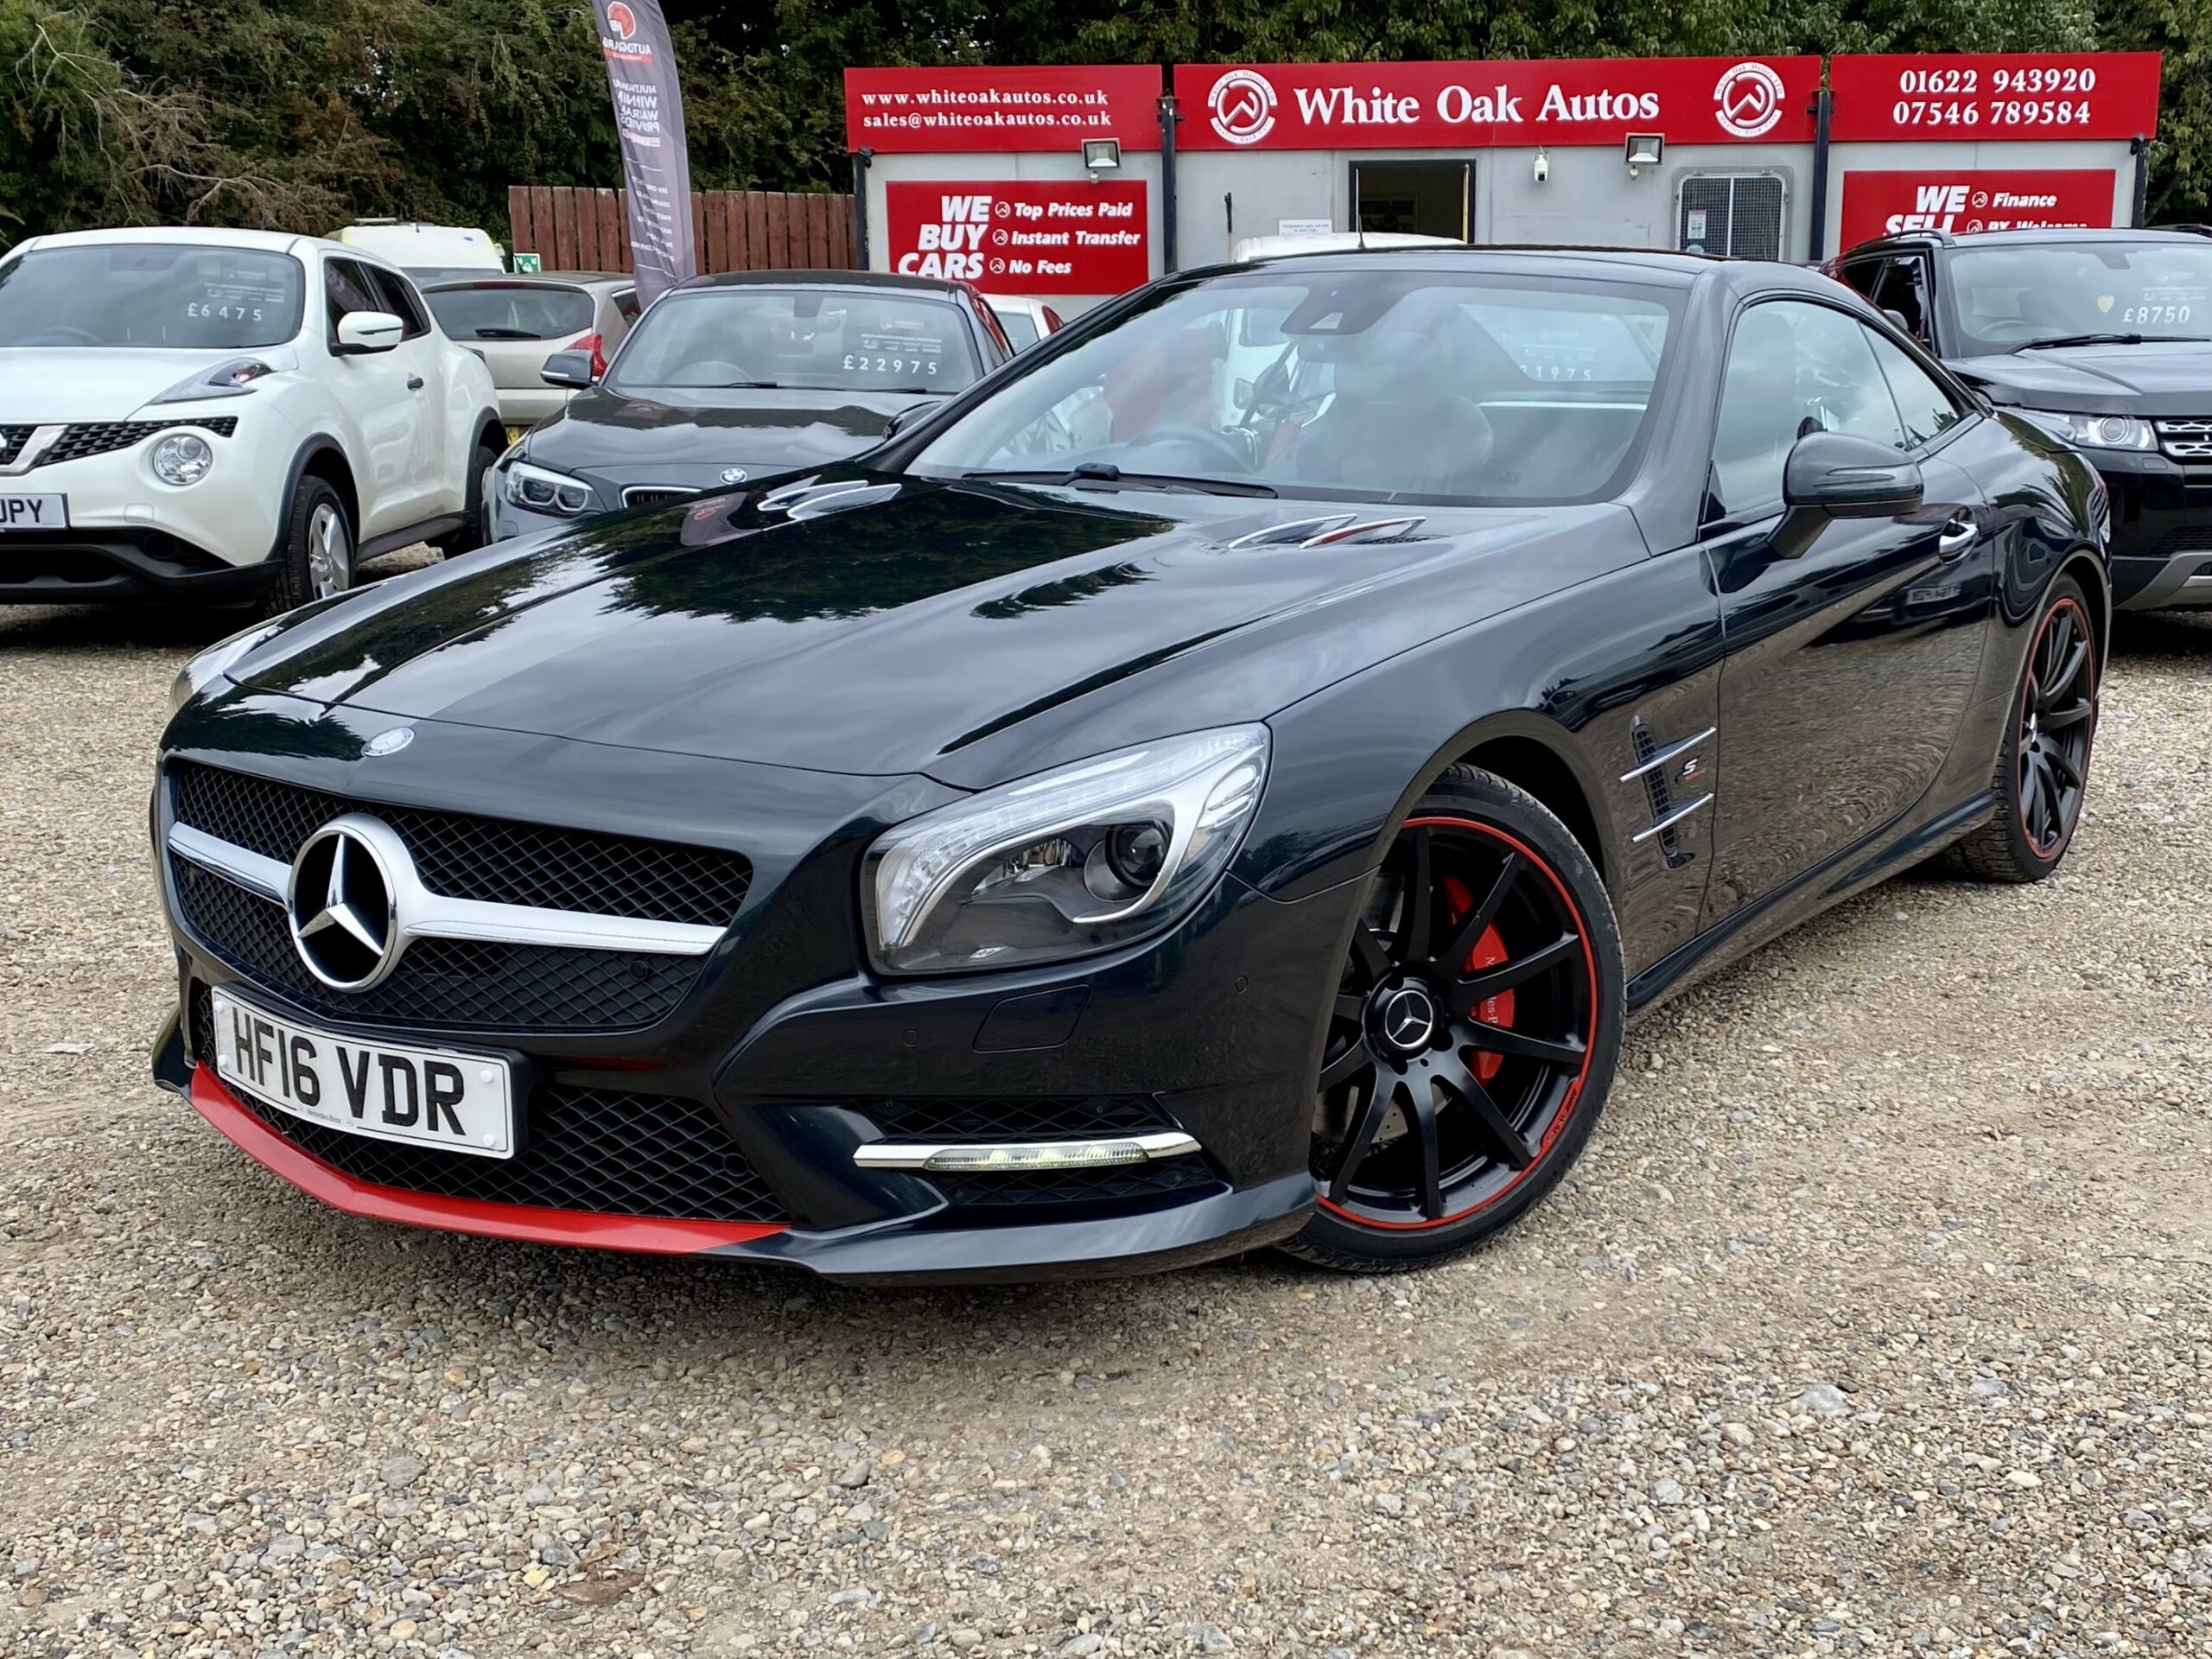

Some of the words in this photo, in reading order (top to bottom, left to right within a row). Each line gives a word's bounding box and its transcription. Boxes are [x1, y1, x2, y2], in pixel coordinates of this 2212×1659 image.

[1899, 69, 1978, 93] 01622
[1993, 68, 2096, 93] 943920
[861, 88, 1109, 105] www.whiteoakautos.co.uk
[1294, 86, 1421, 125] White
[1436, 84, 1524, 124] Oak
[1535, 84, 1660, 122] Autos
[863, 111, 1112, 128] sales@whiteoakautos.co.uk
[1892, 101, 1980, 125] 07546
[1990, 100, 2091, 124] 789584
[941, 195, 993, 222] WE
[1916, 185, 1971, 213] WE
[1992, 192, 2058, 207] Finance
[1014, 202, 1043, 220] Top
[1047, 202, 1093, 218] Prices
[1098, 202, 1134, 217] Paid
[918, 224, 989, 251] BUY
[1011, 230, 1070, 245] Instant
[1075, 230, 1141, 245] Transfer
[898, 252, 985, 279] CARS
[1008, 259, 1032, 274] No
[1037, 259, 1072, 274] Fees
[187, 302, 263, 321] £6475
[2123, 306, 2190, 324] £8750
[842, 354, 938, 375] £22975
[232, 1007, 321, 1107] HF16
[335, 1046, 467, 1136] VDR
